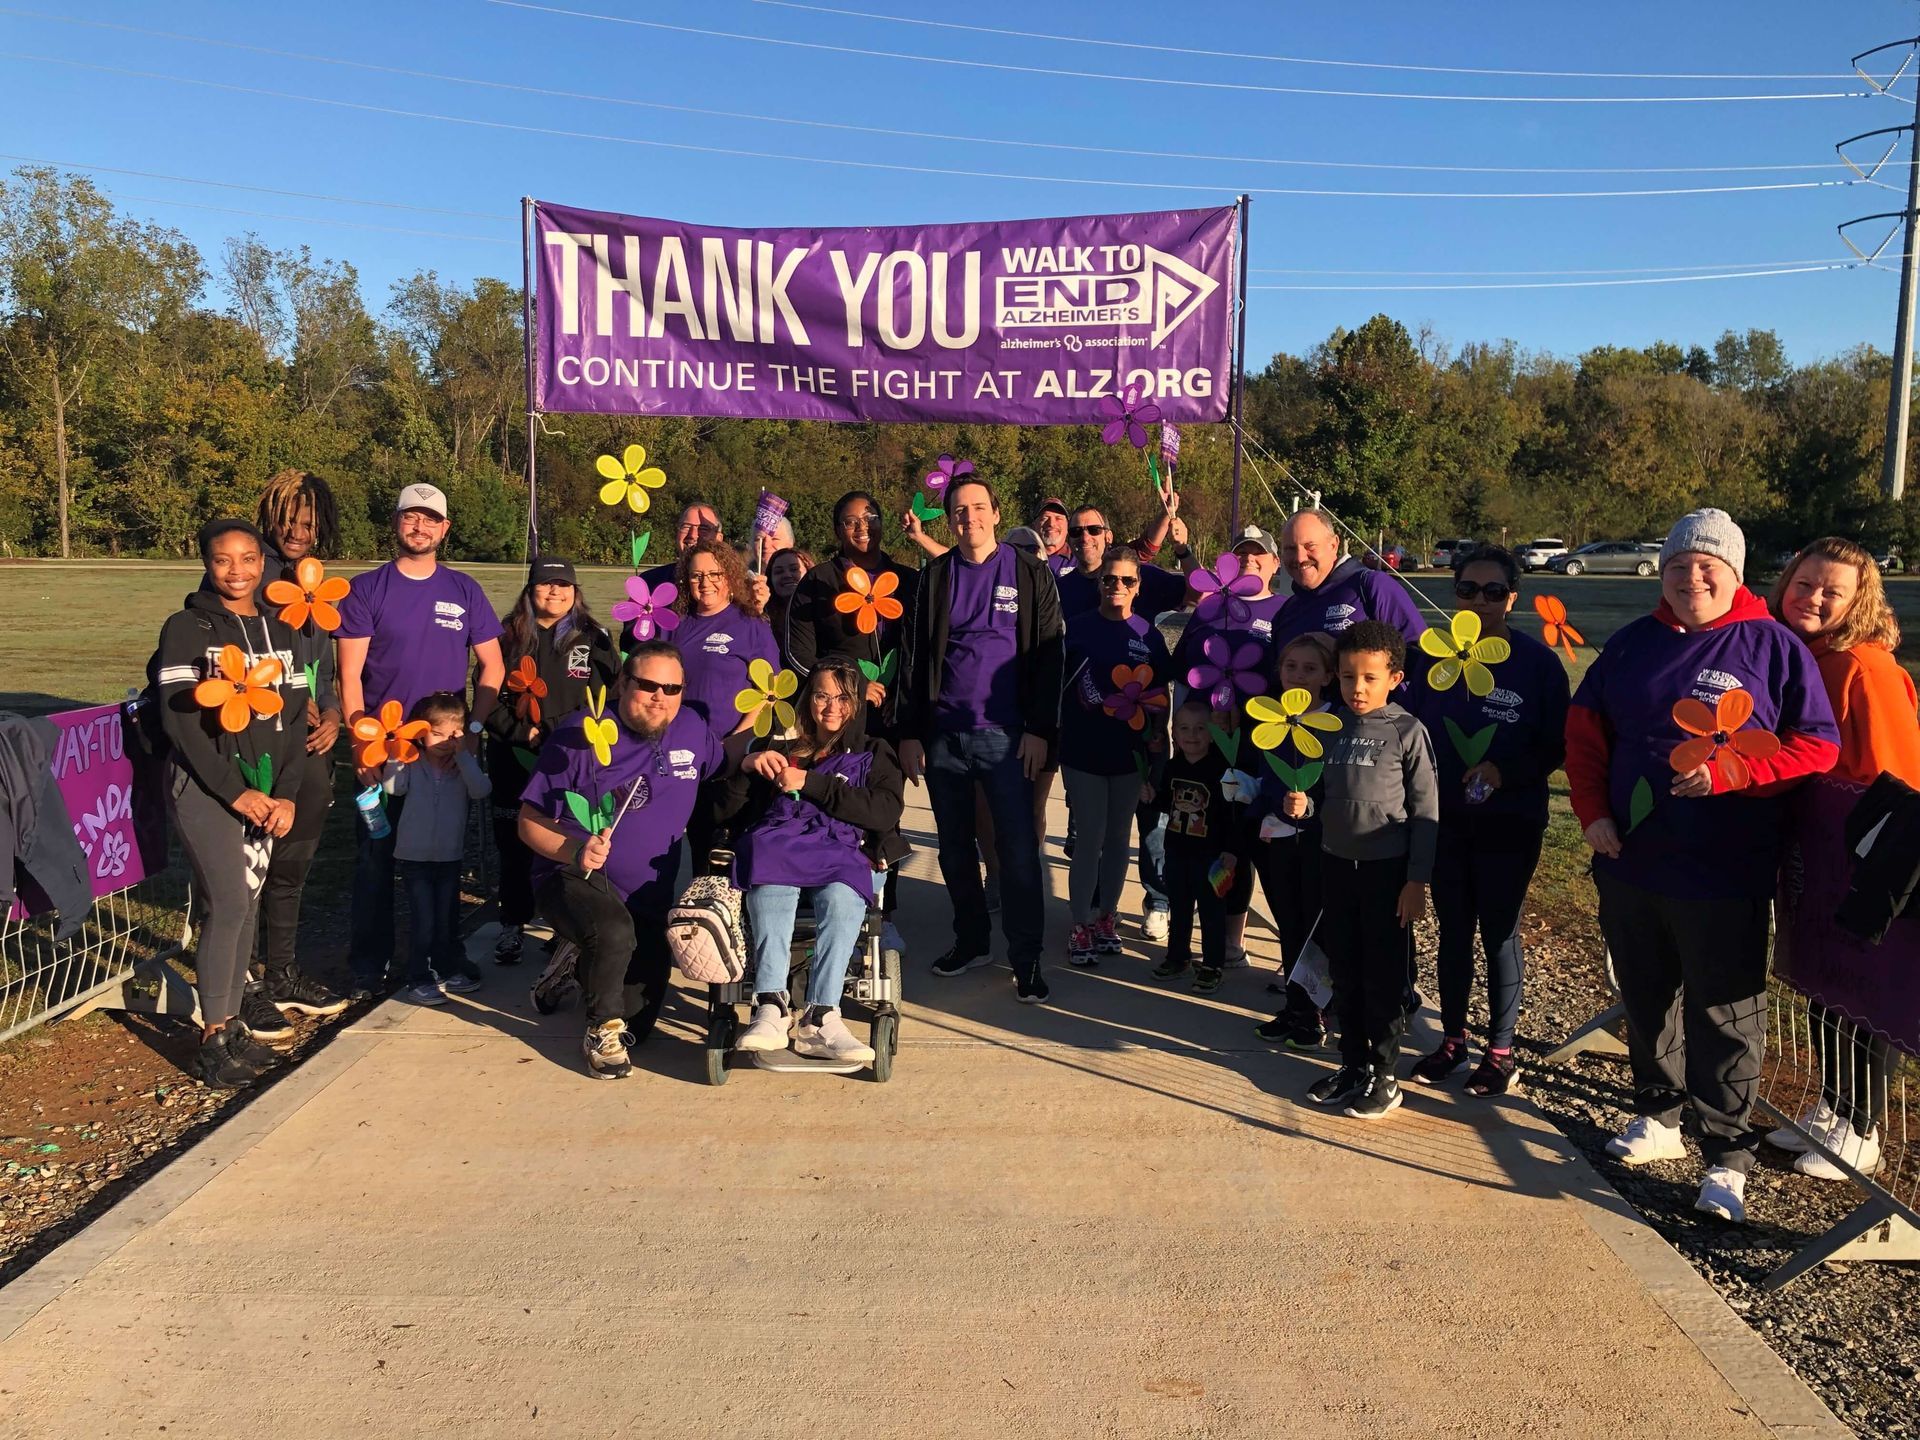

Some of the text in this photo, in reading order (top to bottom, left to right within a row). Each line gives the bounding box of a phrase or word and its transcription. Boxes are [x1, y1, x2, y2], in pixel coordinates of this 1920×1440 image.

[1001, 244, 1141, 273] WALK TO
[545, 231, 981, 350] THANK YOU
[1003, 277, 1141, 308] END
[1001, 307, 1140, 324] ALZHEIMER'S
[1000, 337, 1062, 350] alzheimer's
[558, 355, 756, 391] CONTINUE
[769, 364, 838, 395] THE
[852, 369, 962, 399] FIGHT
[974, 371, 1022, 399] AT
[1033, 367, 1212, 399] ALZ.ORG
